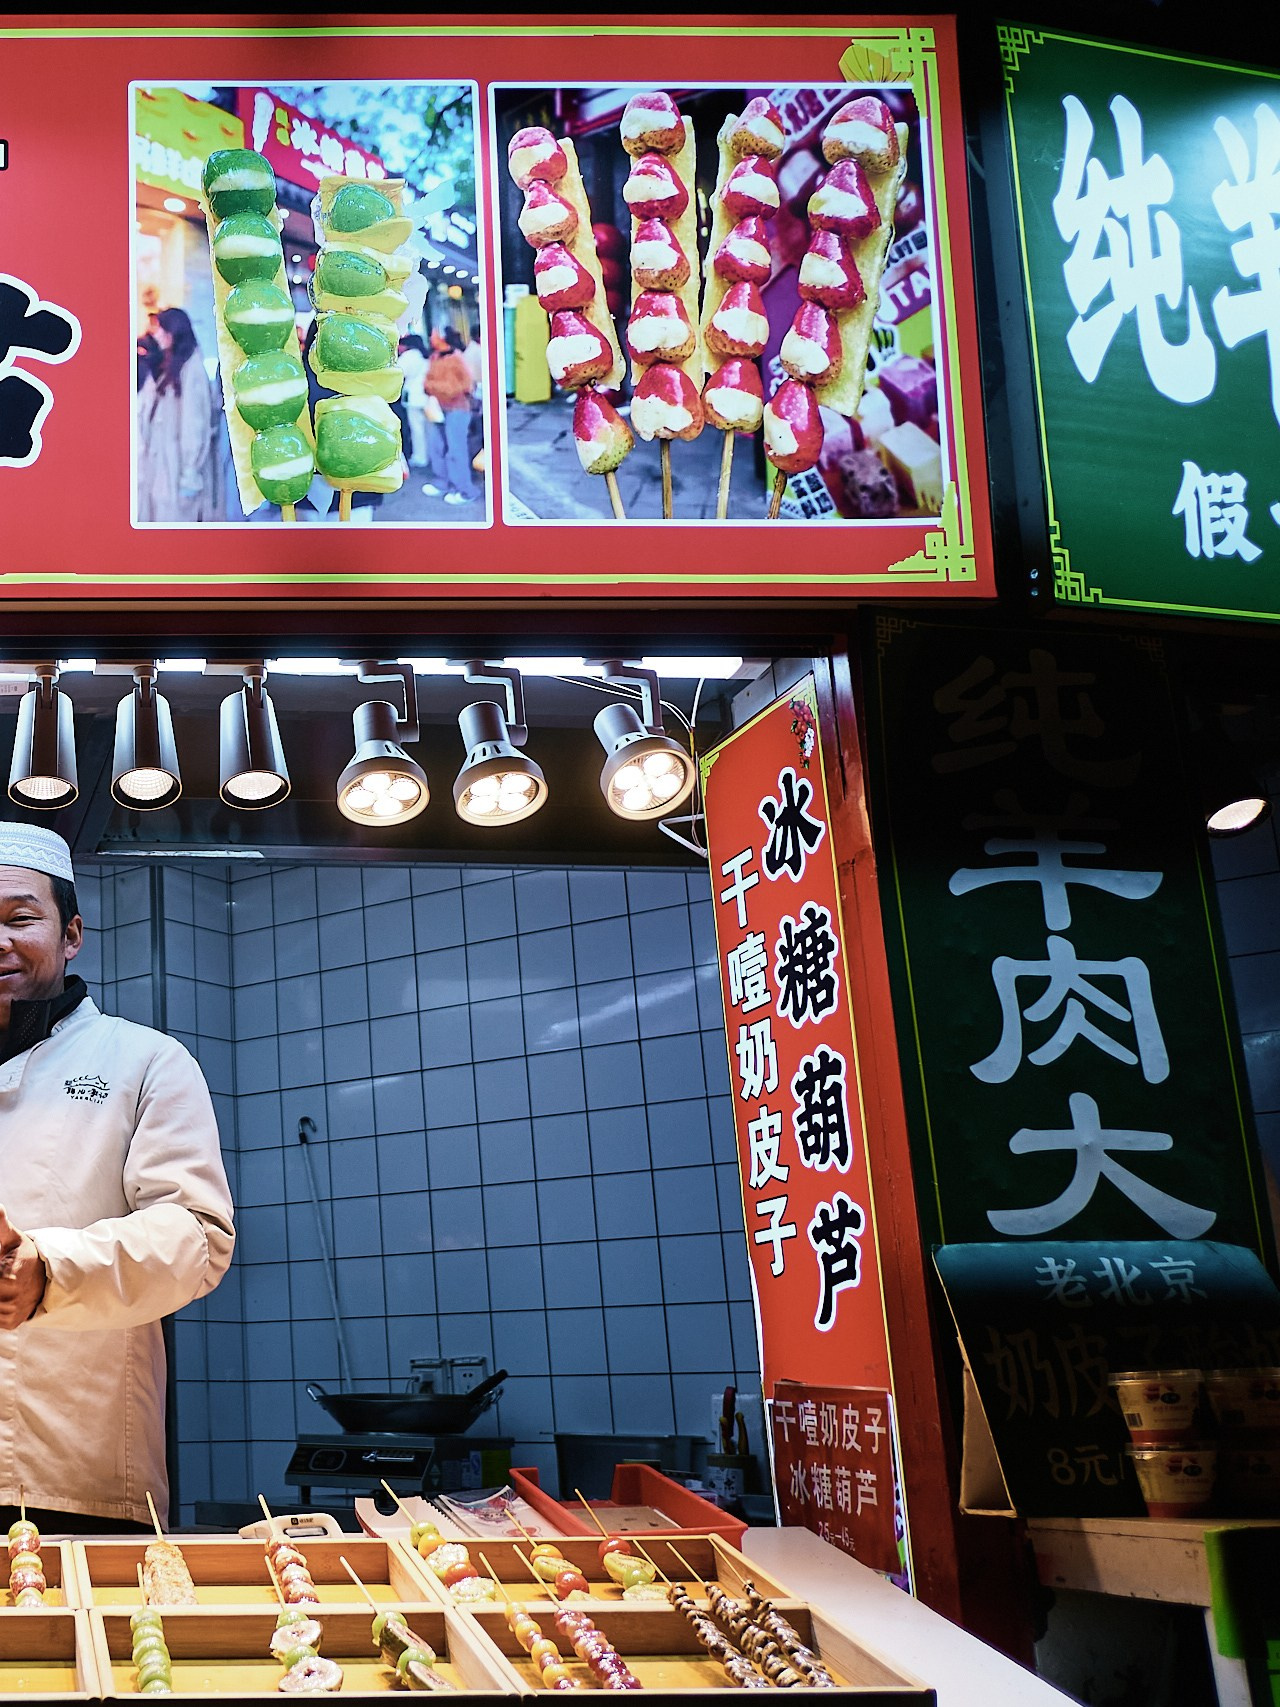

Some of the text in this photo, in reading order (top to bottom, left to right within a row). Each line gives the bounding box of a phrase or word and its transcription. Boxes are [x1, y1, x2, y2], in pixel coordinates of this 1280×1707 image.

[720, 848, 797, 1278] 干噎奶皮子
[759, 767, 866, 1333] 冰糖葫芦
[1034, 1255, 1209, 1308] 老北京
[775, 1399, 887, 1454] 干噎奶皮子
[789, 1460, 878, 1516] 冰糖葫芦
